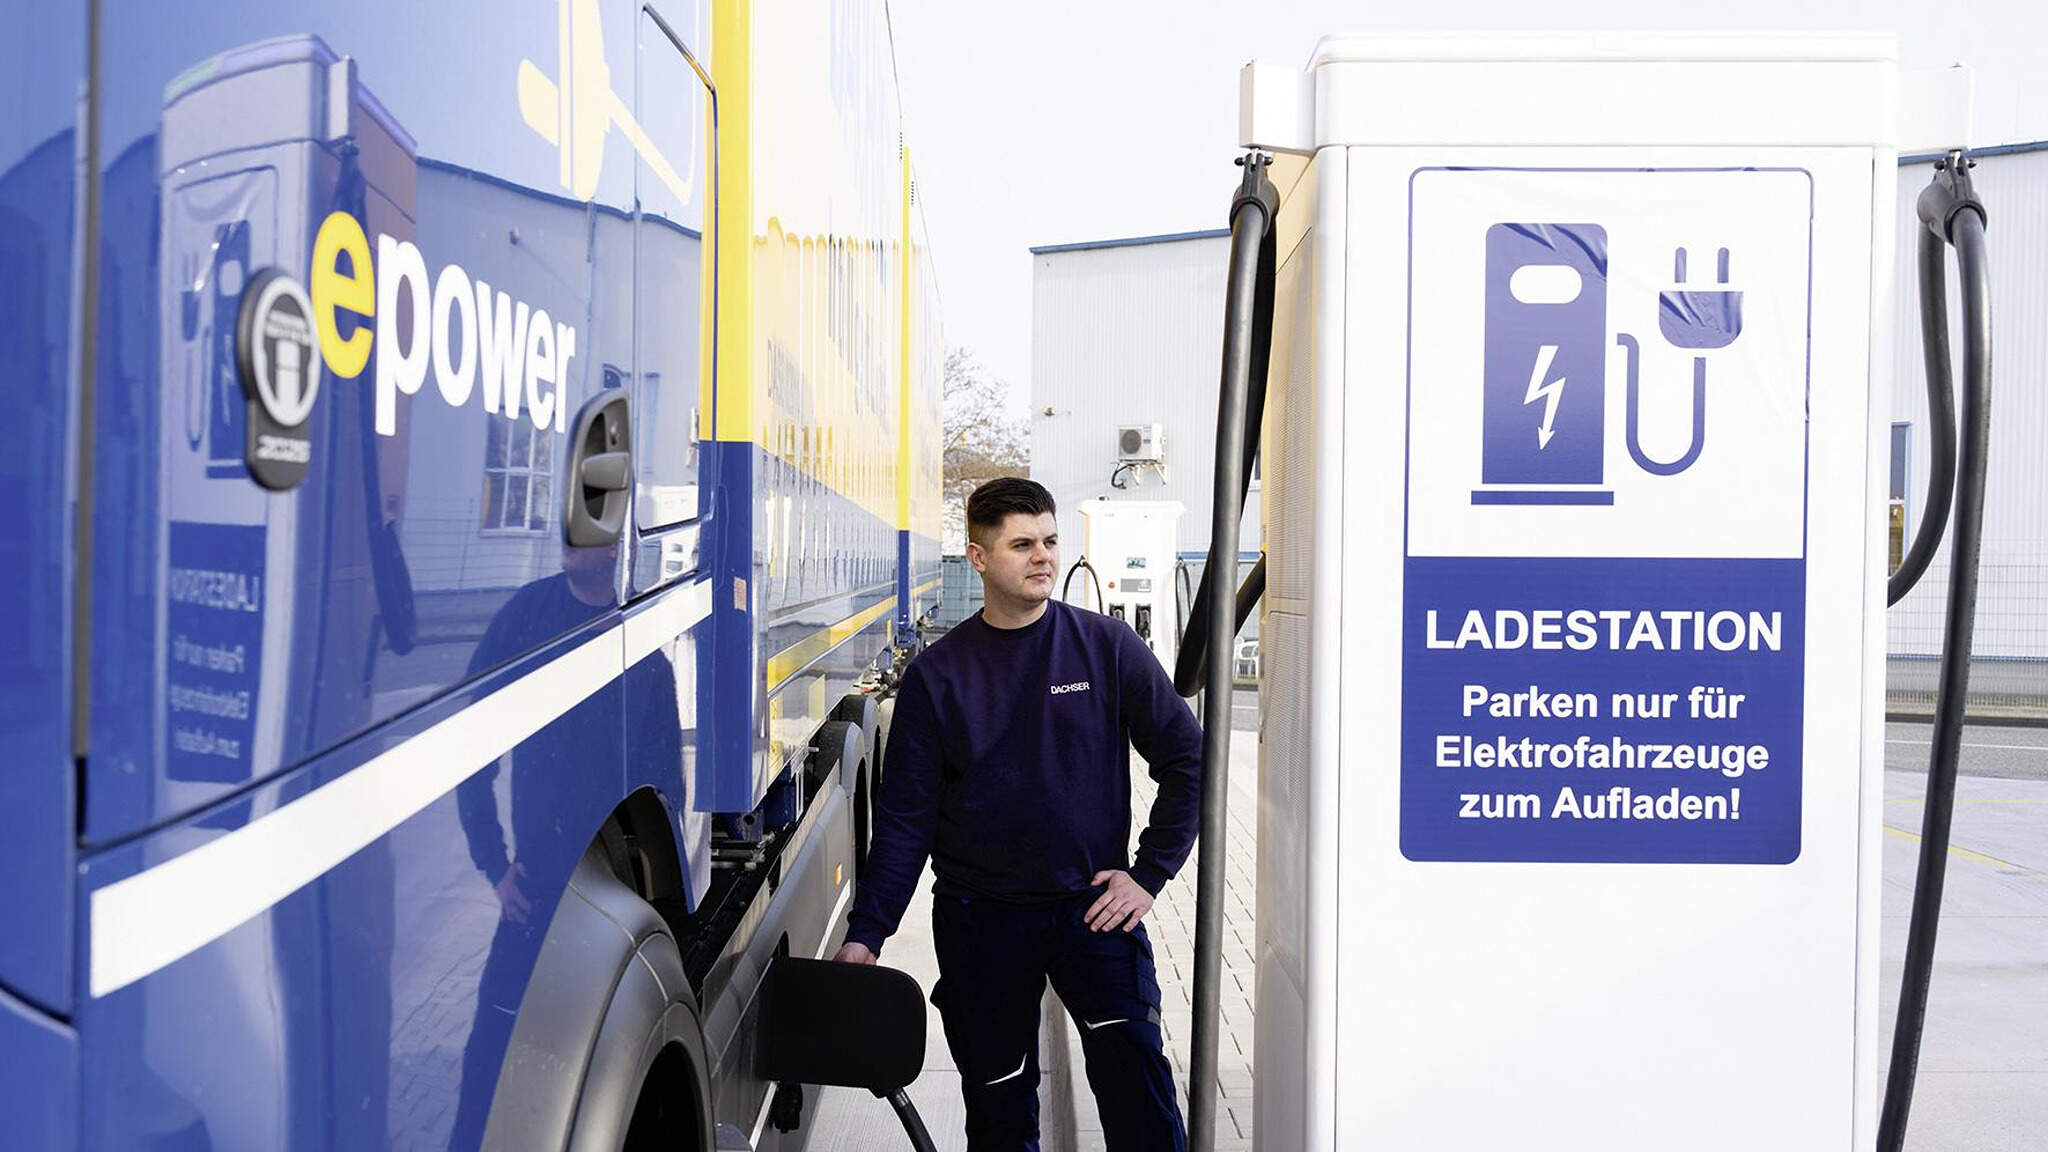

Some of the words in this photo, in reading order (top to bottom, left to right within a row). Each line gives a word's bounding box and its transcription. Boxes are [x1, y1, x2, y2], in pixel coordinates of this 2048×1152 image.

[311, 210, 576, 436] epower
[1426, 609, 1782, 652] LADESTATION
[1050, 681, 1090, 695] DACHSER
[1462, 684, 1598, 718] Parken
[1611, 693, 1678, 719] nur
[1687, 685, 1746, 719] für
[1435, 735, 1769, 778] Elektrofahrzeuge
[1458, 793, 1541, 819] zum
[1551, 786, 1740, 820] Aufladen!
